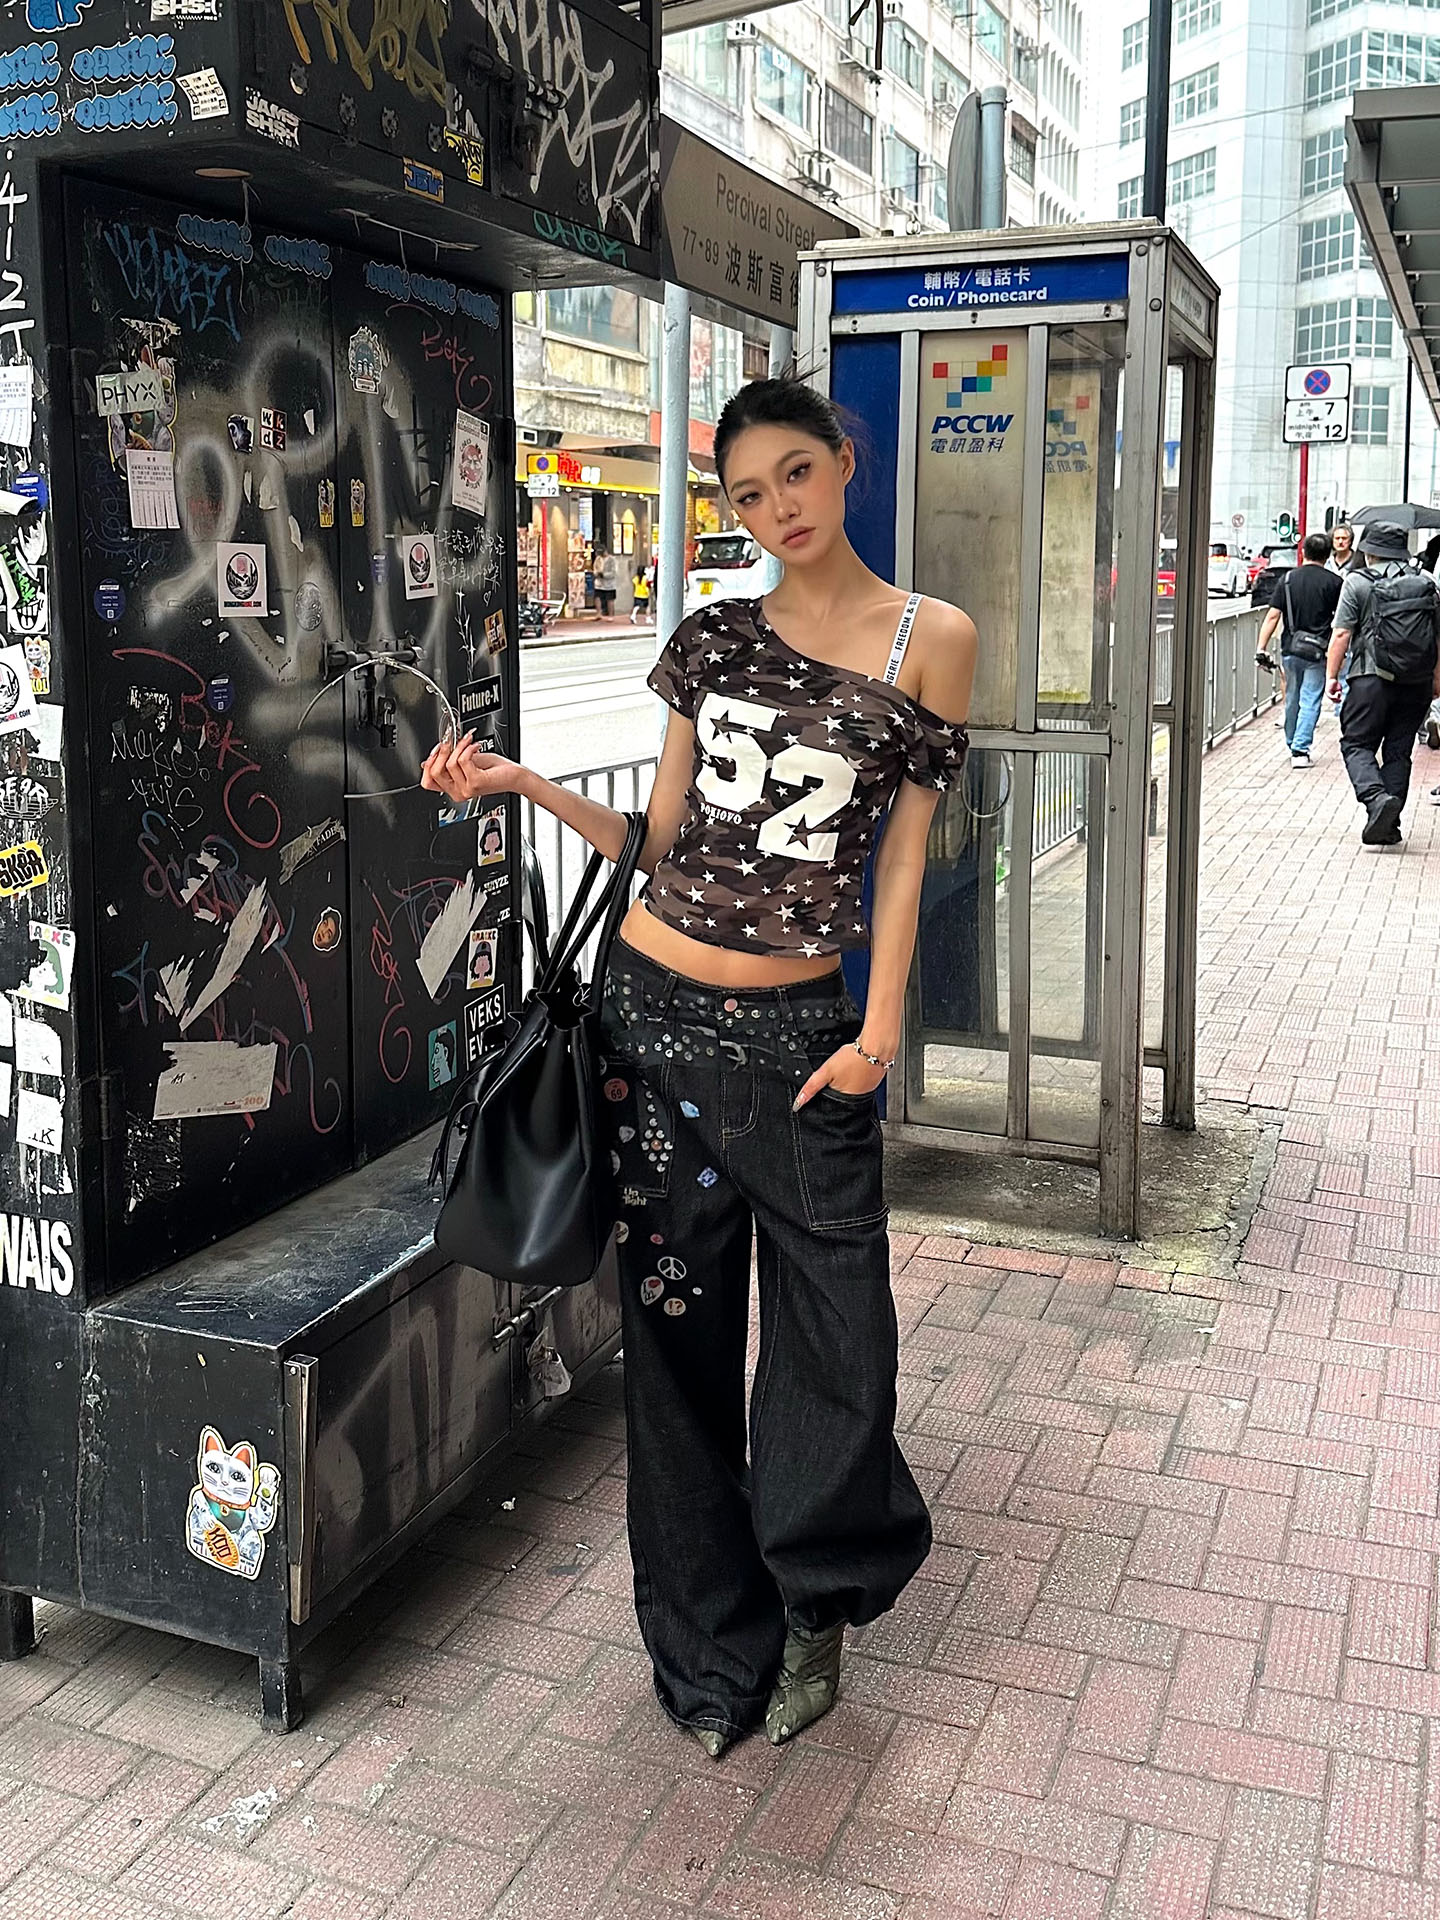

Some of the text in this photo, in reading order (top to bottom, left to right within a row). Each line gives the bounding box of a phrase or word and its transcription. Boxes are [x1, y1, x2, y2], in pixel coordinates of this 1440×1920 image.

[246, 96, 299, 127] JAMS
[716, 172, 816, 251] Percival Street
[101, 382, 156, 406] PHYX
[1325, 401, 1335, 415] 7
[931, 414, 1014, 434] PCCW
[1288, 423, 1321, 431] midnight
[1325, 424, 1343, 438] 12
[930, 436, 1005, 454] 電訊盈科
[547, 474, 553, 483] 7
[547, 487, 557, 495] 12
[894, 616, 912, 652] FREEDOM
[461, 683, 500, 713] Future-X
[469, 993, 501, 1032] VEKS
